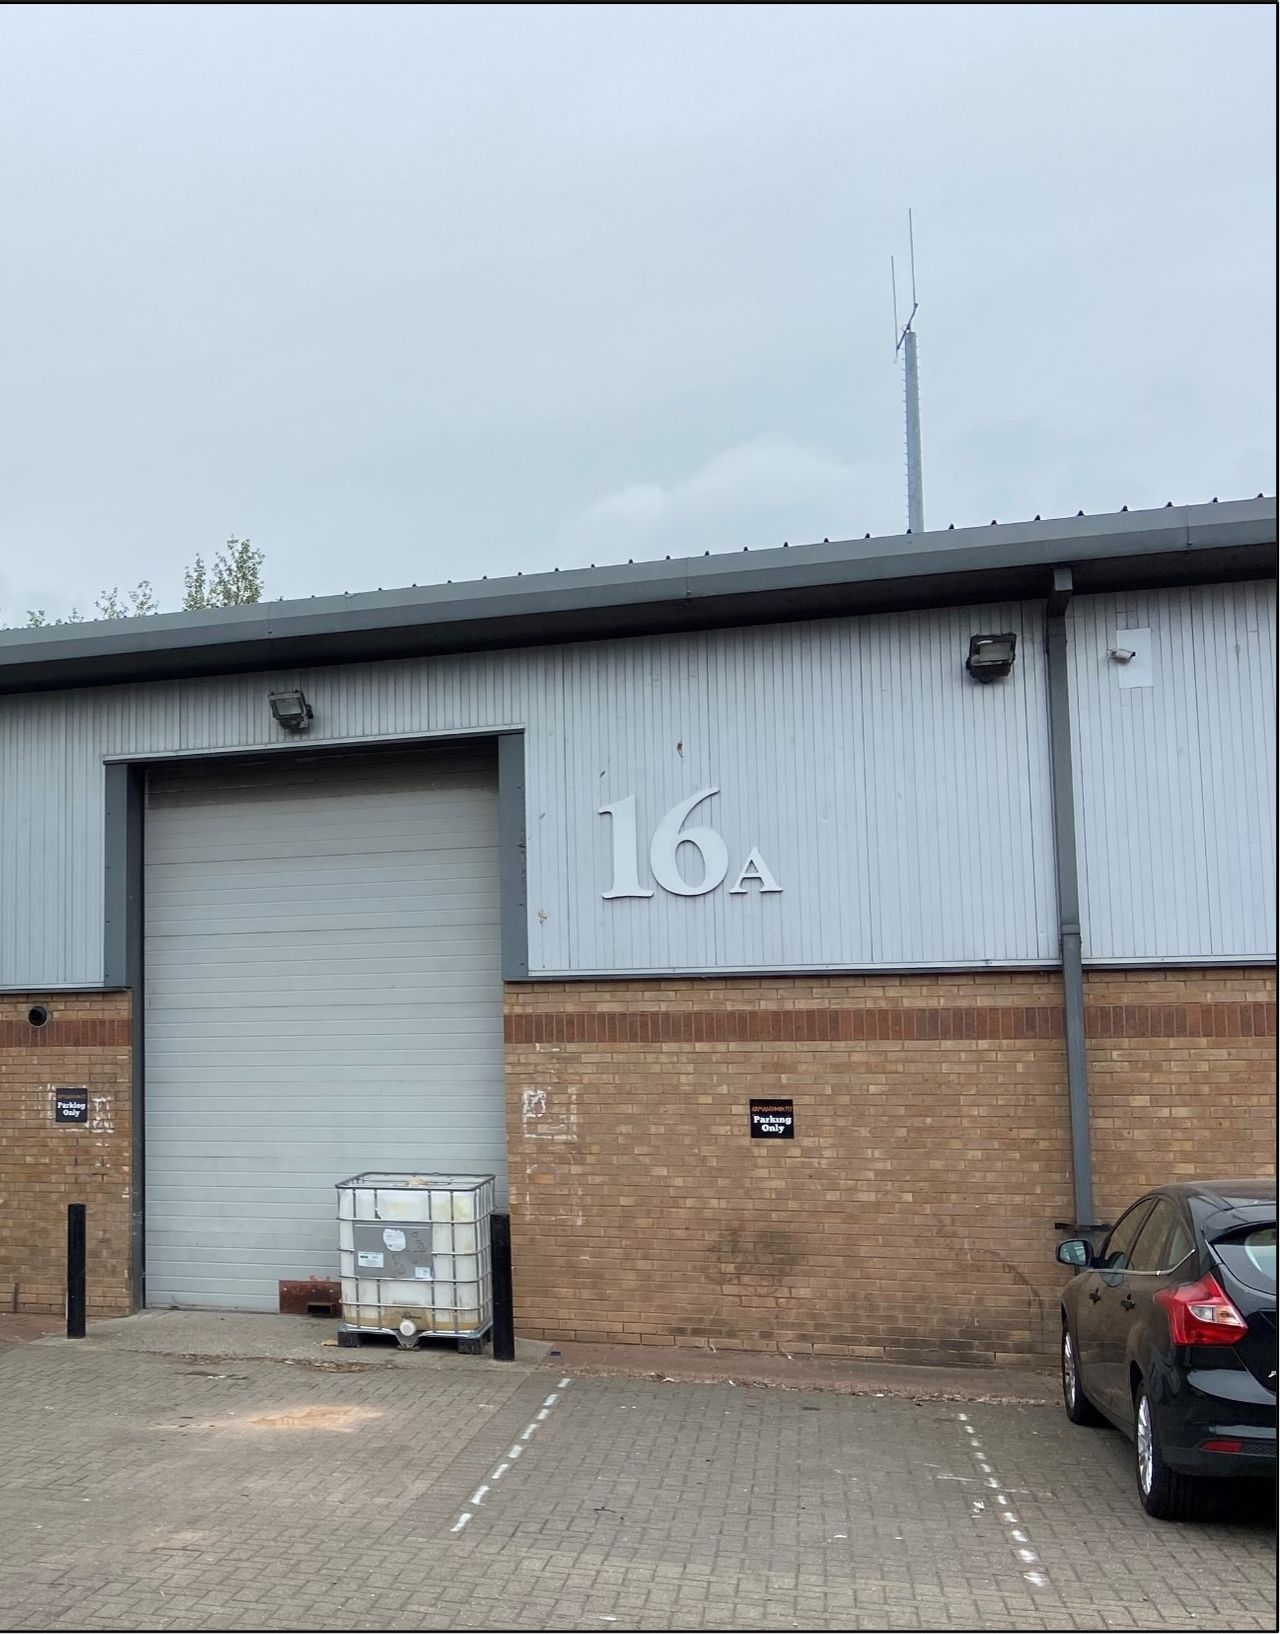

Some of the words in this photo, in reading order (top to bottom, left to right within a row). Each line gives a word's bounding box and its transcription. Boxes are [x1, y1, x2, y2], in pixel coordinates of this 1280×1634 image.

[57, 1101, 86, 1111] Parking
[62, 1109, 80, 1118] Only
[753, 1115, 792, 1125] Parking
[761, 1124, 785, 1134] Only
